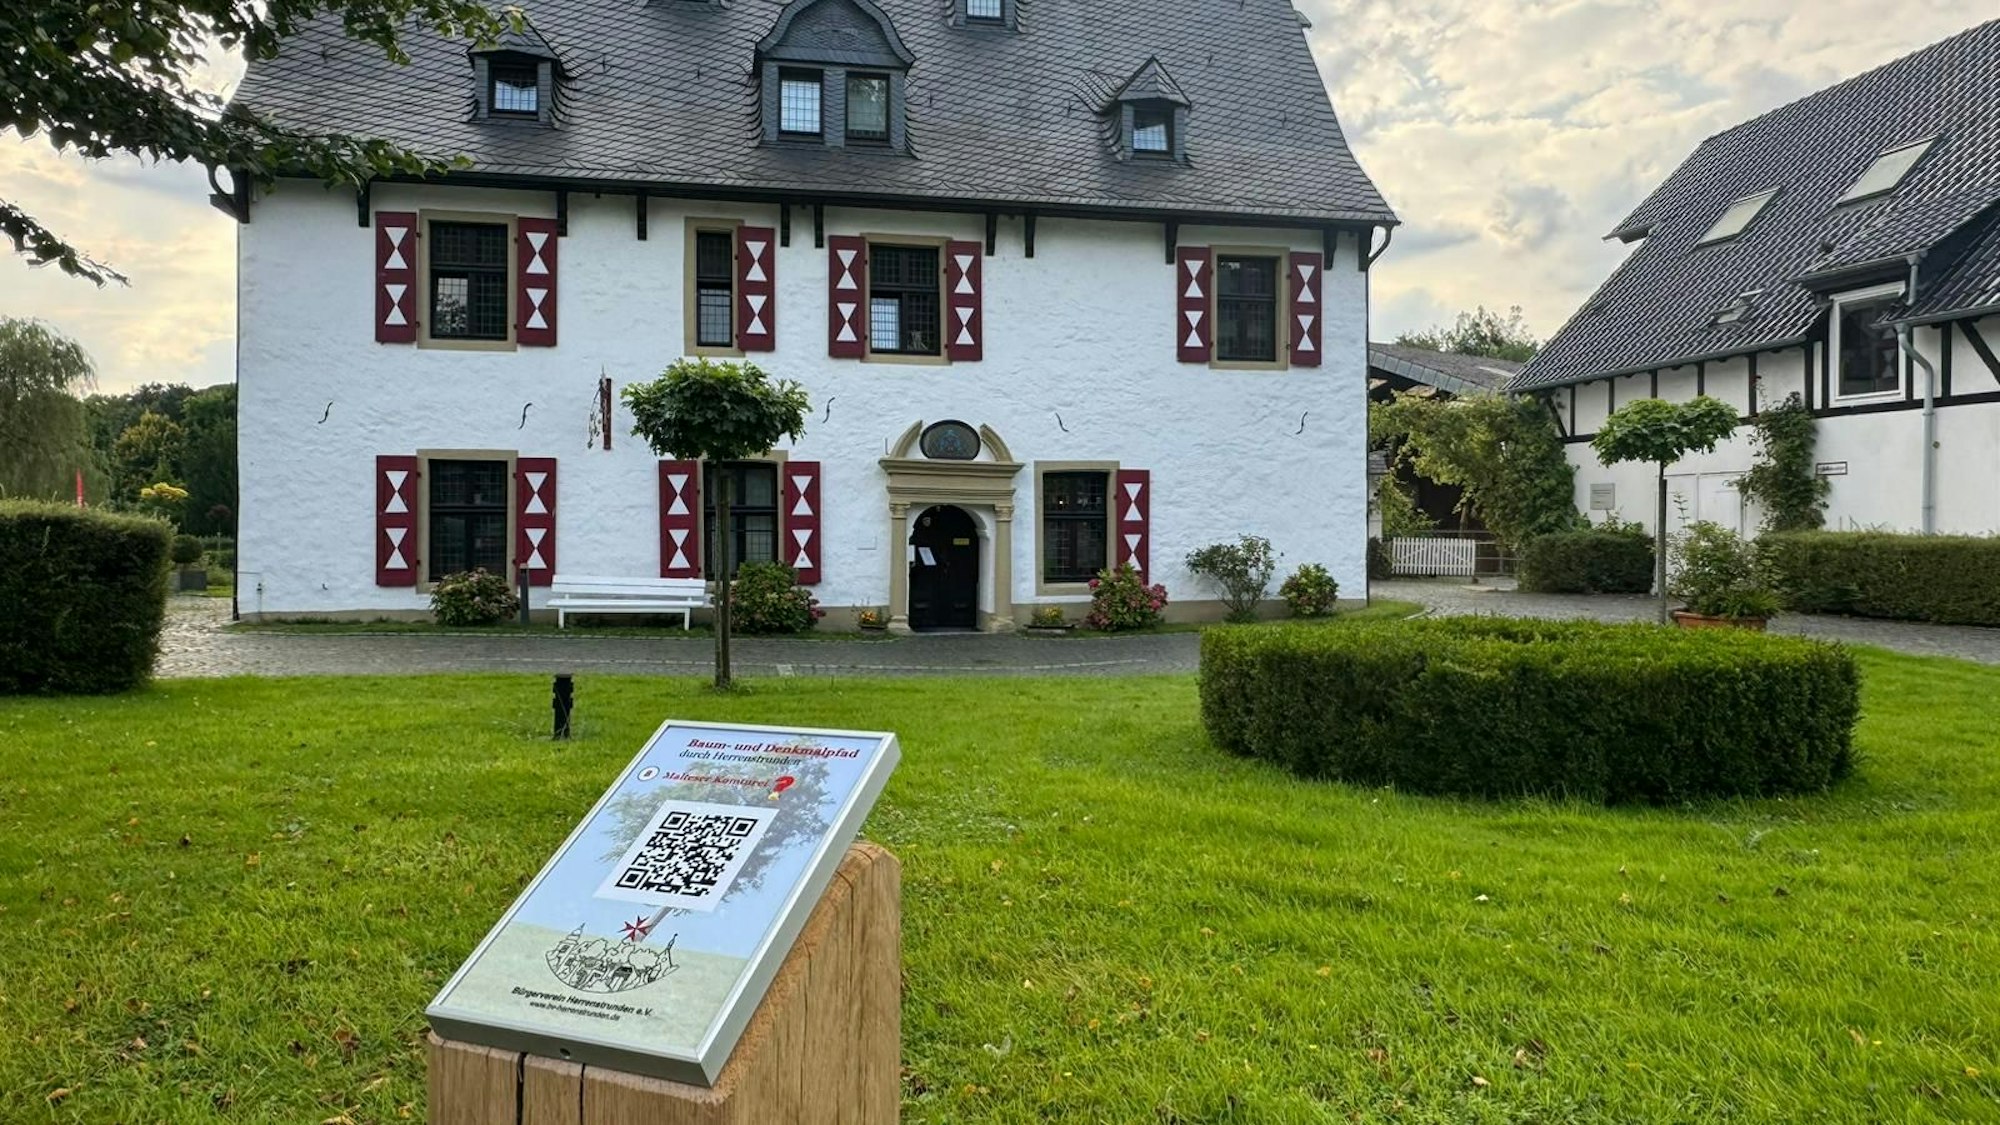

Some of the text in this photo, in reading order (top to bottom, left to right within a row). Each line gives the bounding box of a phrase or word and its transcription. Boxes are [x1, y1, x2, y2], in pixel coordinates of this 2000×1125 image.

[687, 738, 860, 758] Baum- und Denkmalpfad
[679, 749, 801, 766] durch Herrenstrunden
[662, 772, 769, 787] Malteser Komturei
[511, 986, 653, 1017] Bürgerverein Herrenstrunden e.V.
